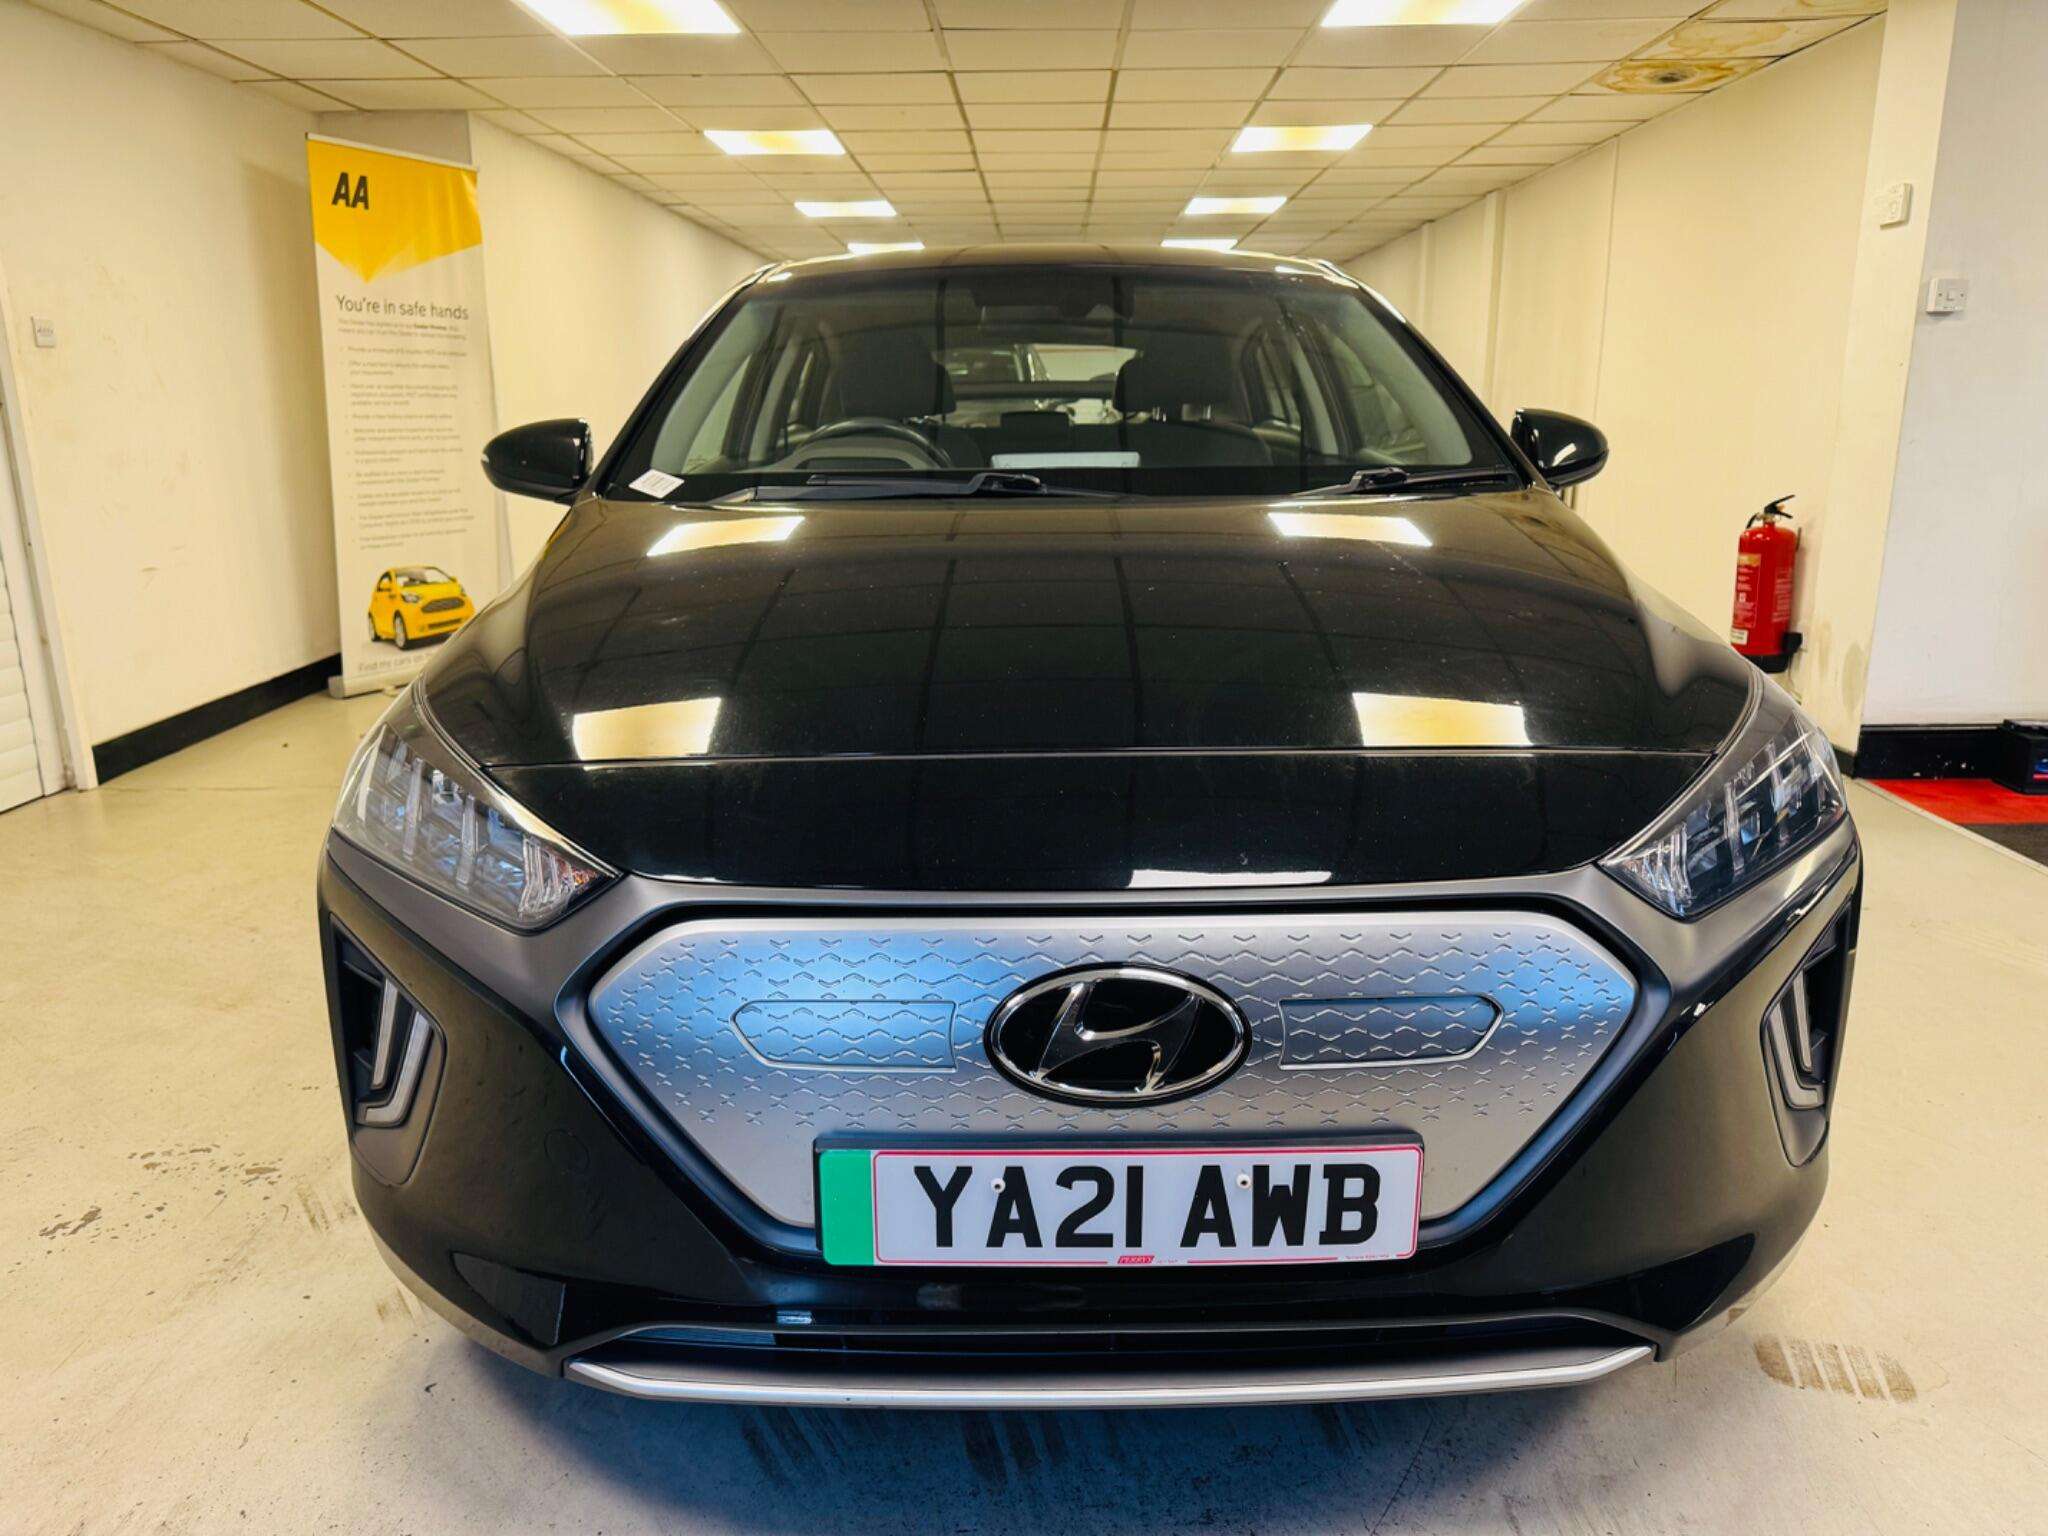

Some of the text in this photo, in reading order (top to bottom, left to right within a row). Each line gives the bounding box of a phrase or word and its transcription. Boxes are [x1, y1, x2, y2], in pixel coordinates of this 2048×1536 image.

[331, 171, 369, 210] AA
[336, 294, 469, 321] You're in safe hands
[913, 1163, 1381, 1248] YA21 AWB
